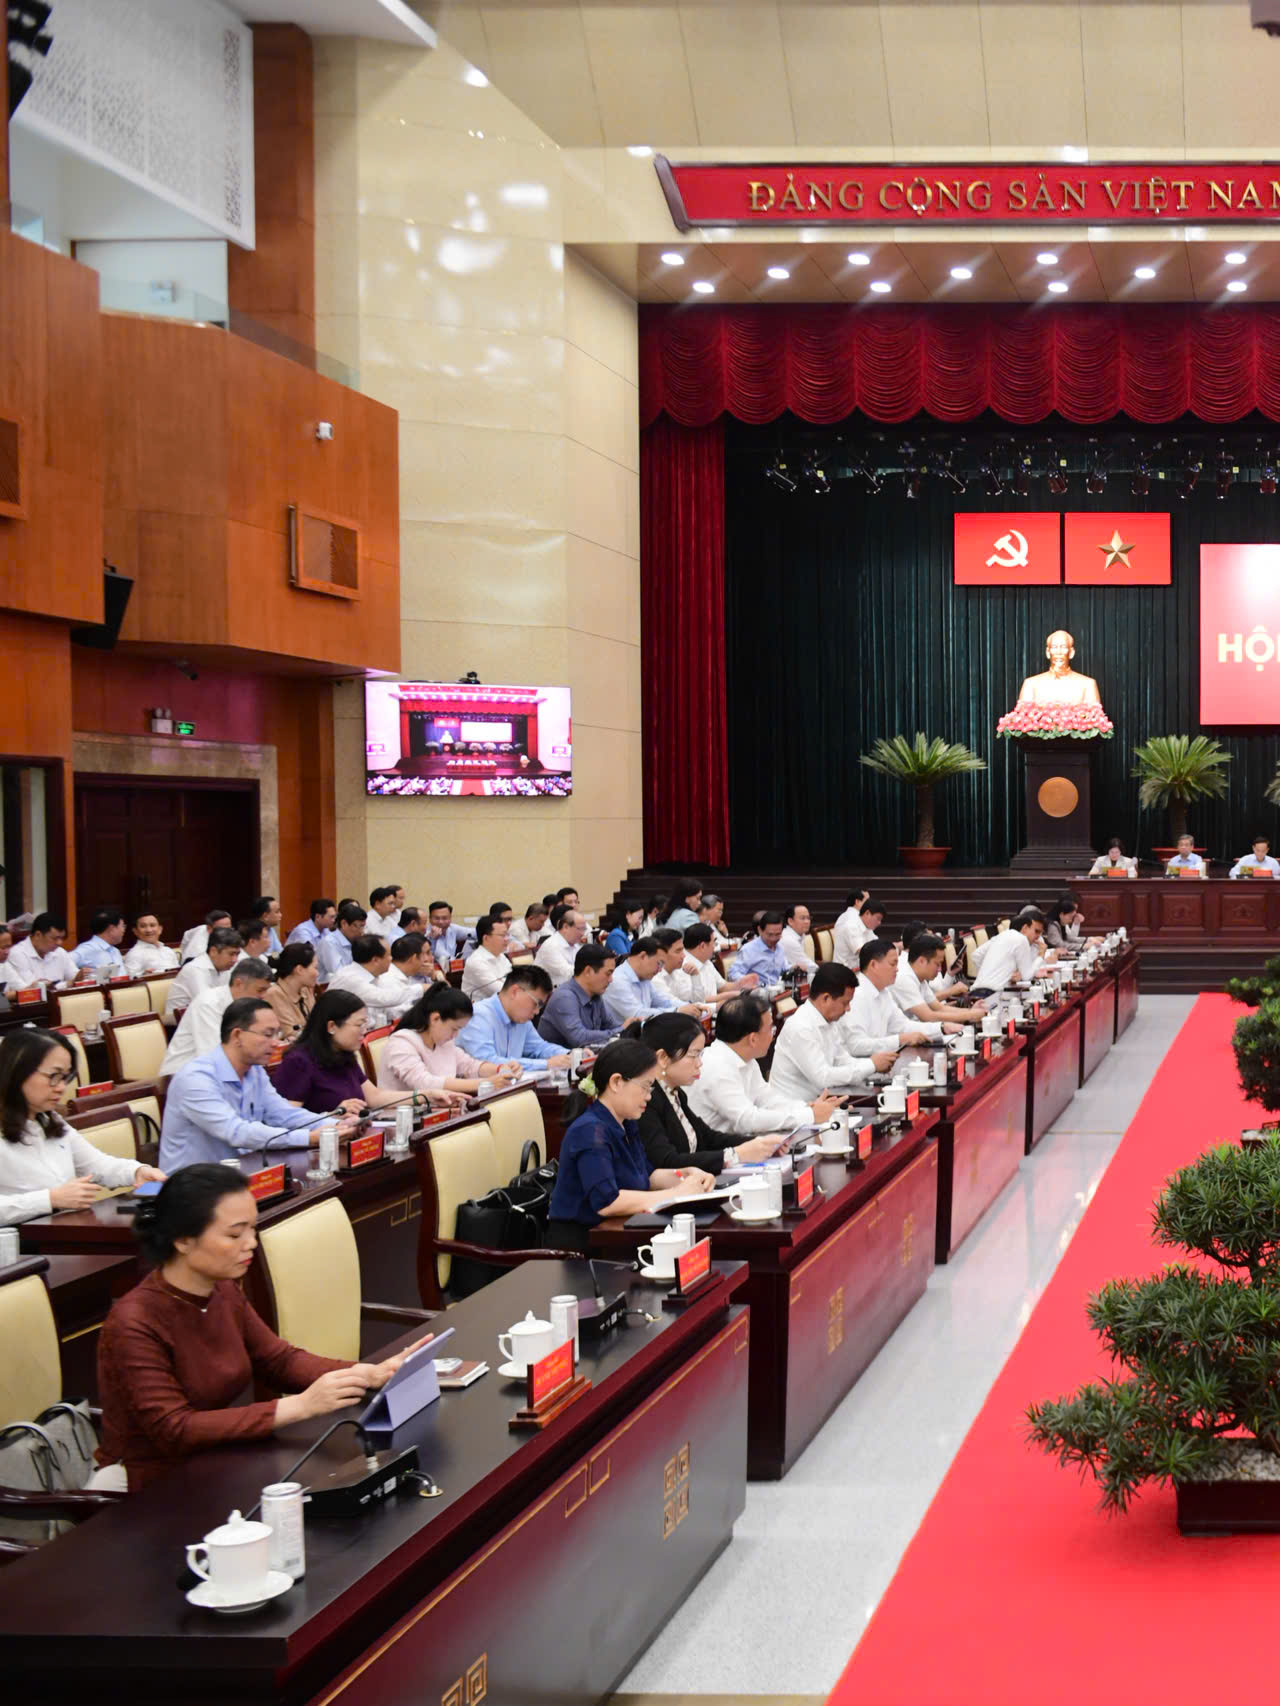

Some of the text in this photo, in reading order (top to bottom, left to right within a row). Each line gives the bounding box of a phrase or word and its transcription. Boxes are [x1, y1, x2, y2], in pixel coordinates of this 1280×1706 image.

[748, 174, 865, 213] ĐẢNG
[879, 177, 993, 215] CỘNG
[1008, 173, 1088, 212] SẢN
[1102, 177, 1194, 214] VIỆT
